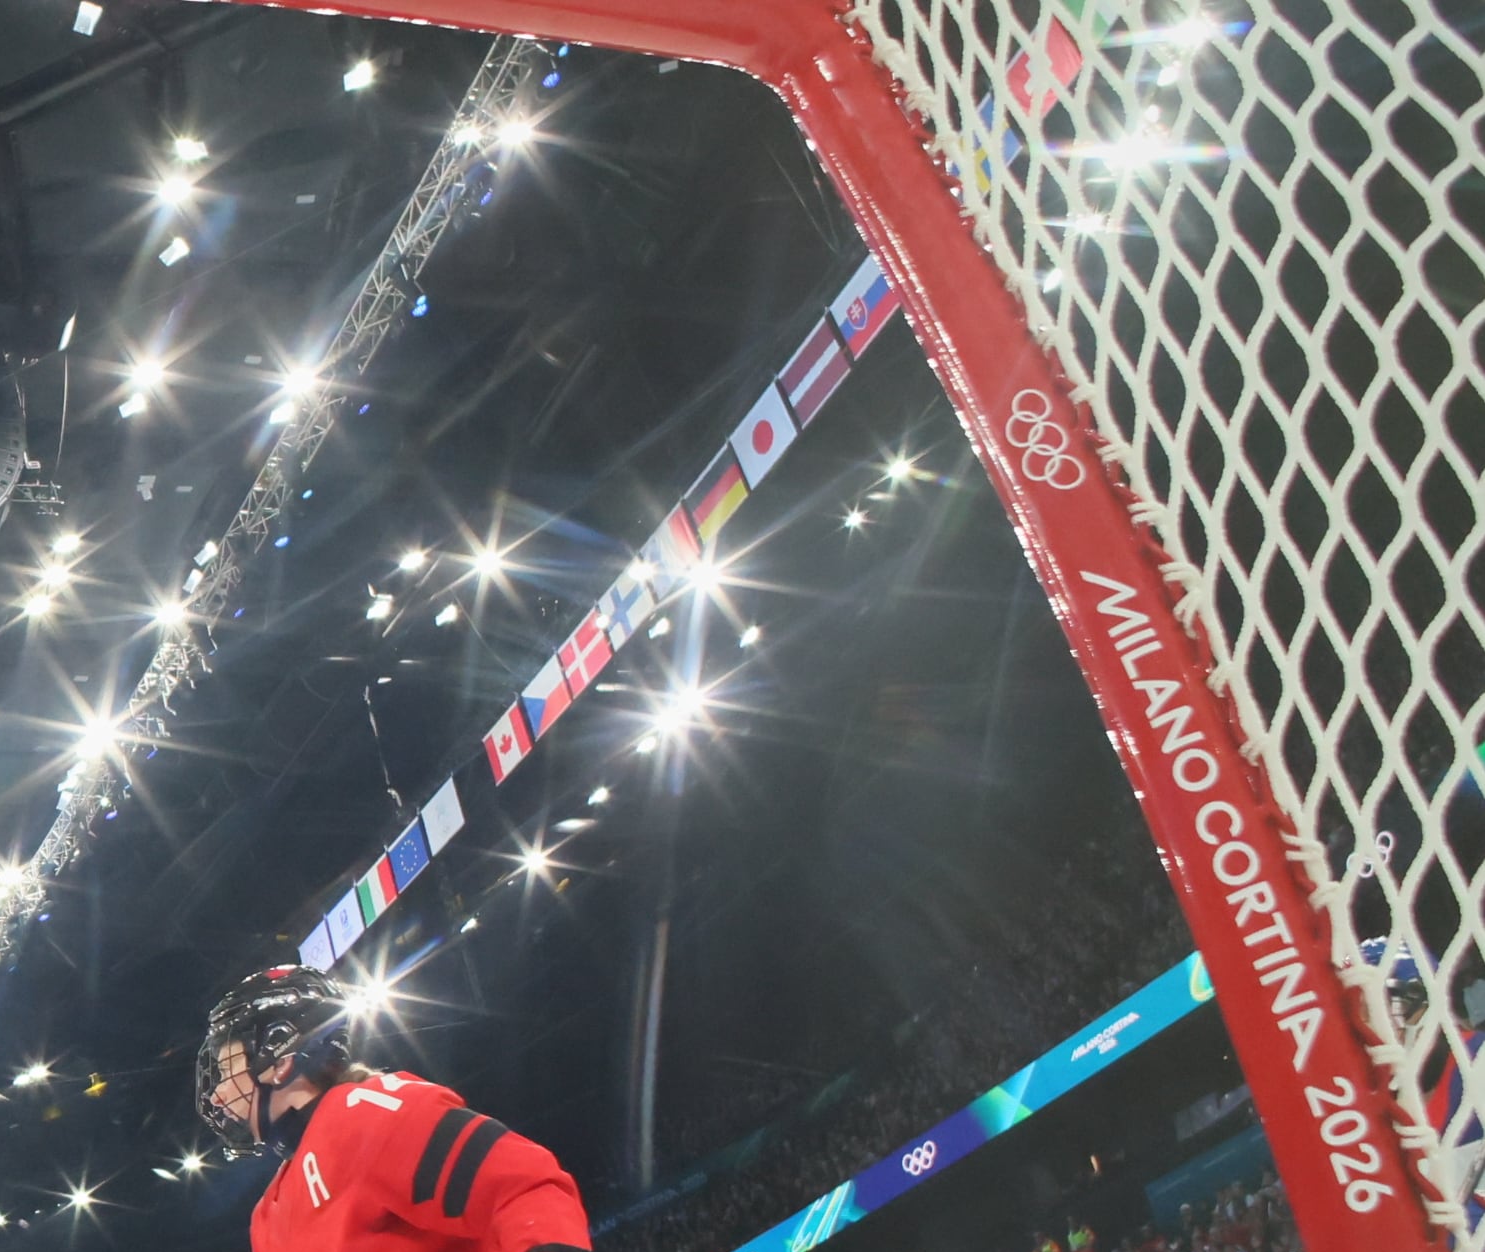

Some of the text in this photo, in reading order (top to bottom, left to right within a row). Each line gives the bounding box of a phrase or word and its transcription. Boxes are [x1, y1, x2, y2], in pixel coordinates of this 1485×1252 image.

[1080, 569, 1395, 1214] MILANO CORTINA 2026
[302, 1151, 331, 1208] A
